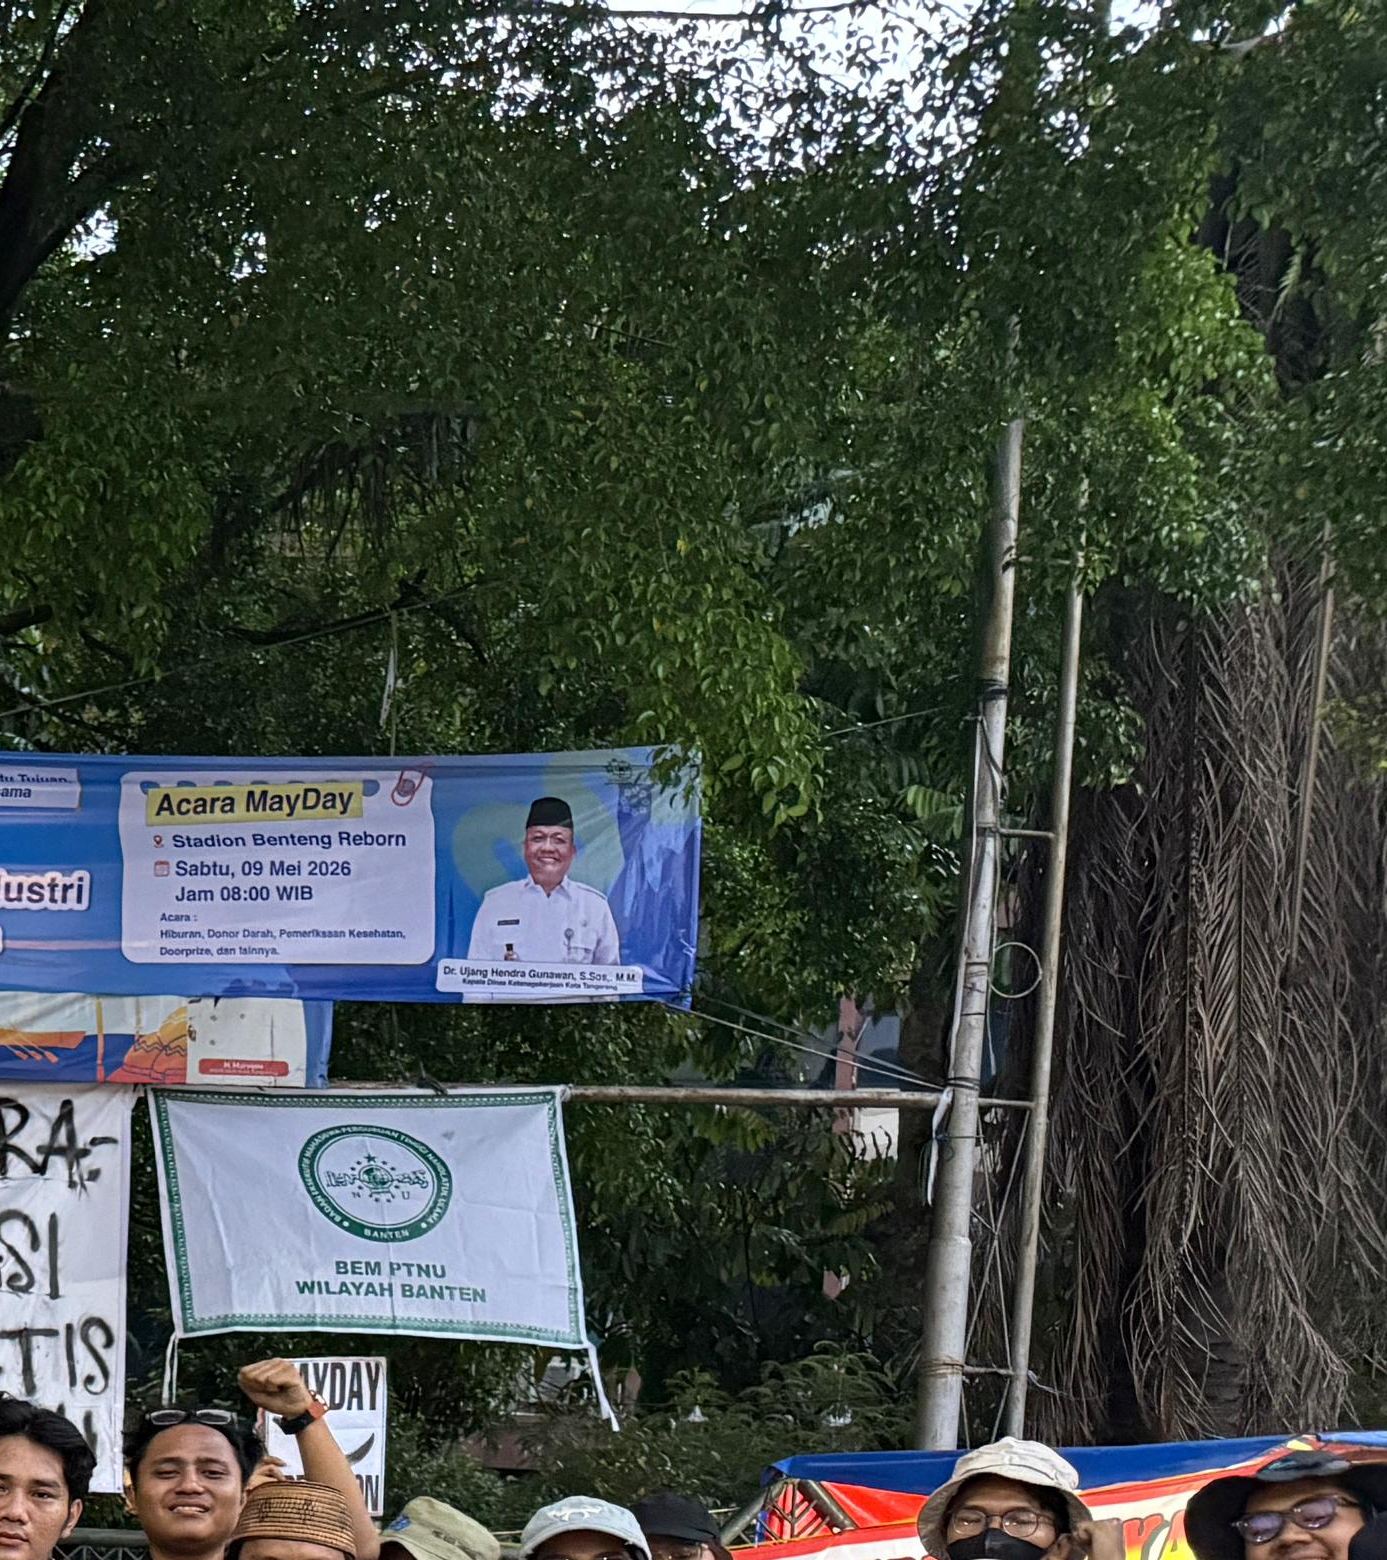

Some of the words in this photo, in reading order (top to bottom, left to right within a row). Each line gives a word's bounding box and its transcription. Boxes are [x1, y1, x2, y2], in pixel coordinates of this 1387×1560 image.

[154, 793, 236, 816] Acara
[245, 787, 354, 818] MayDay
[172, 834, 246, 849] Stadion
[252, 833, 332, 850] Benteng
[338, 831, 407, 847] Reborn
[175, 860, 235, 879] Sabtu,
[241, 860, 263, 877] 09
[269, 861, 302, 877] Mei
[308, 860, 352, 877] 2026
[175, 887, 214, 903] Jam
[220, 886, 270, 902] 08:00
[275, 885, 314, 901] WIB
[159, 912, 191, 922] Acara
[159, 928, 205, 940] Hiburan,
[207, 928, 240, 939] Donor
[242, 928, 276, 940] Darah,
[216, 946, 236, 956] dan
[443, 966, 457, 975] Dr.
[460, 966, 488, 978] Ujang
[491, 967, 526, 979] Hendra
[334, 1260, 382, 1277] BEM
[389, 1261, 447, 1279] PTNU
[295, 1280, 394, 1298] WILAYAH
[401, 1283, 487, 1304] BANTEN
